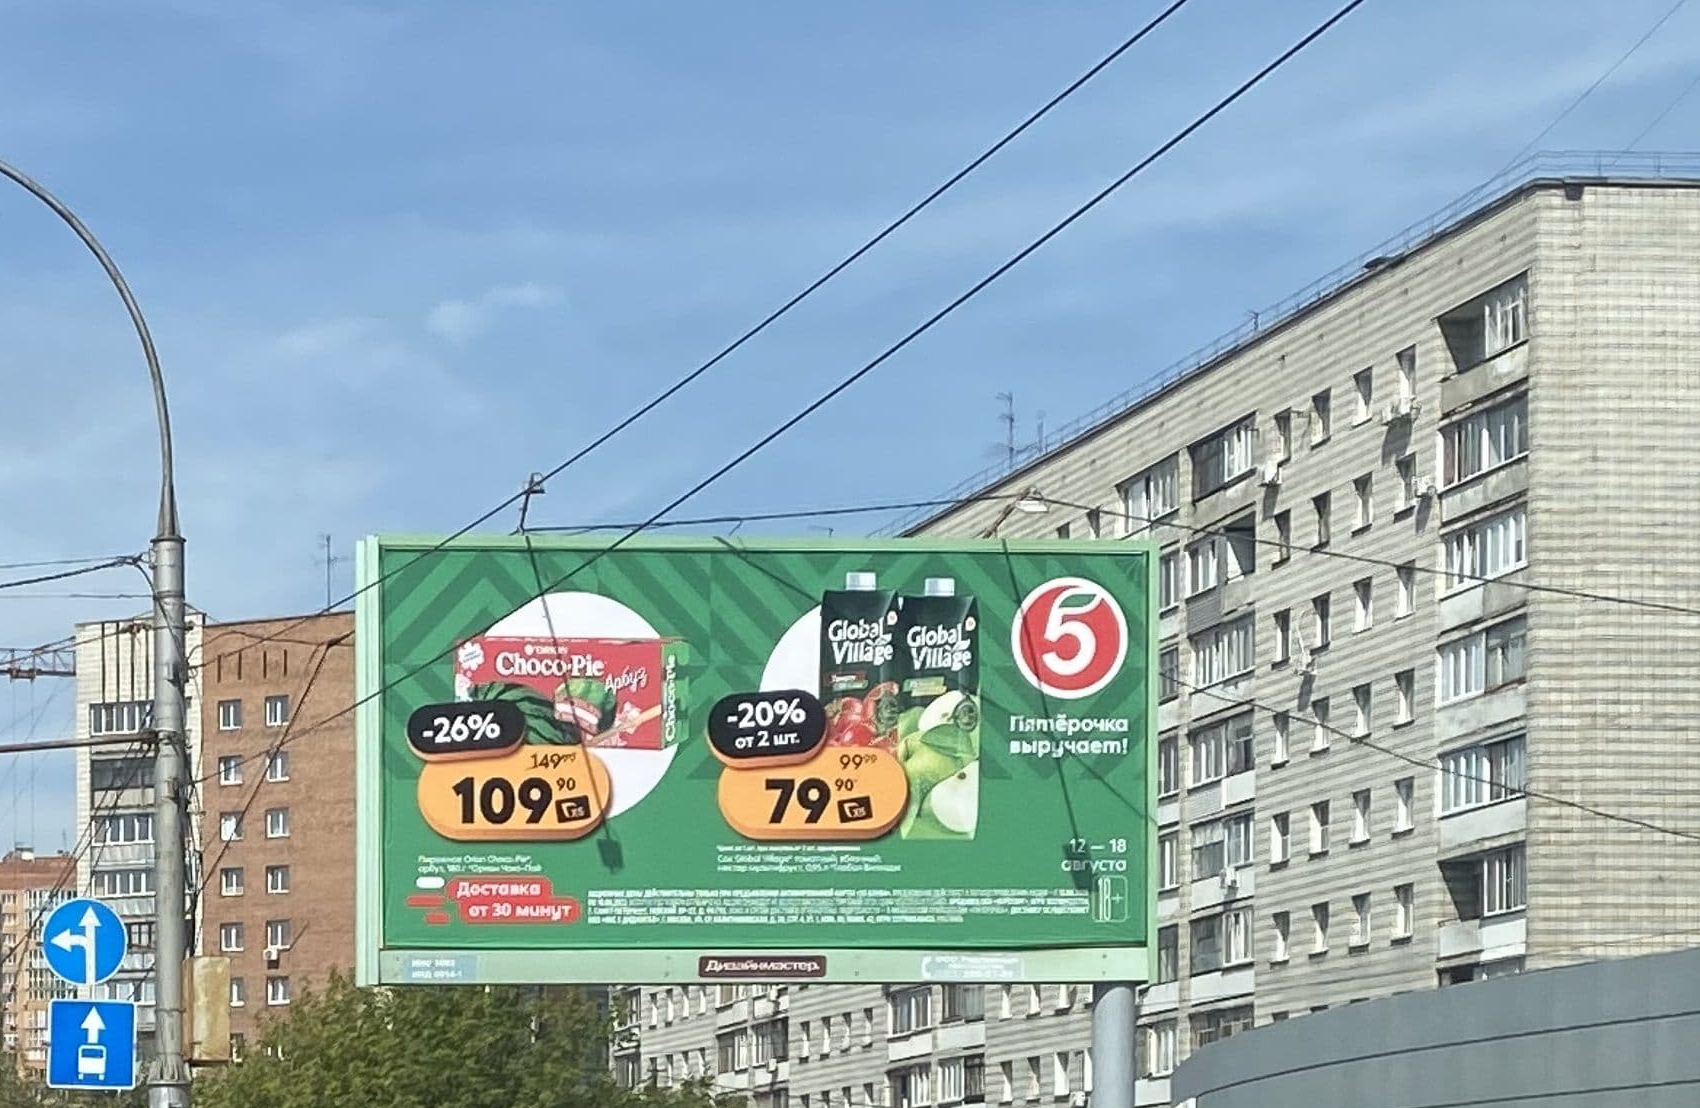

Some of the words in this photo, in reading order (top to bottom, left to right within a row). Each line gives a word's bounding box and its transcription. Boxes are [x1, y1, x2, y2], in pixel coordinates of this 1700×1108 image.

[828, 616, 892, 642] Global
[907, 622, 971, 648] Global
[1041, 585, 1098, 676] 5
[832, 640, 894, 666] Village
[911, 645, 972, 671] Village
[605, 666, 648, 695] Арбуз
[727, 698, 807, 729] -20%
[1010, 713, 1129, 736] Пятёрочка
[422, 712, 501, 744] -26%
[735, 736, 755, 750] от
[757, 731, 771, 747] 2
[773, 733, 801, 746] шт.
[1010, 738, 1129, 758] выручает!
[1069, 838, 1086, 853] 12
[1108, 838, 1127, 853] 18
[1061, 860, 1127, 874] августа
[457, 881, 542, 899] Доставка
[469, 905, 489, 917] от
[491, 902, 512, 917] 30
[515, 904, 573, 922] минут
